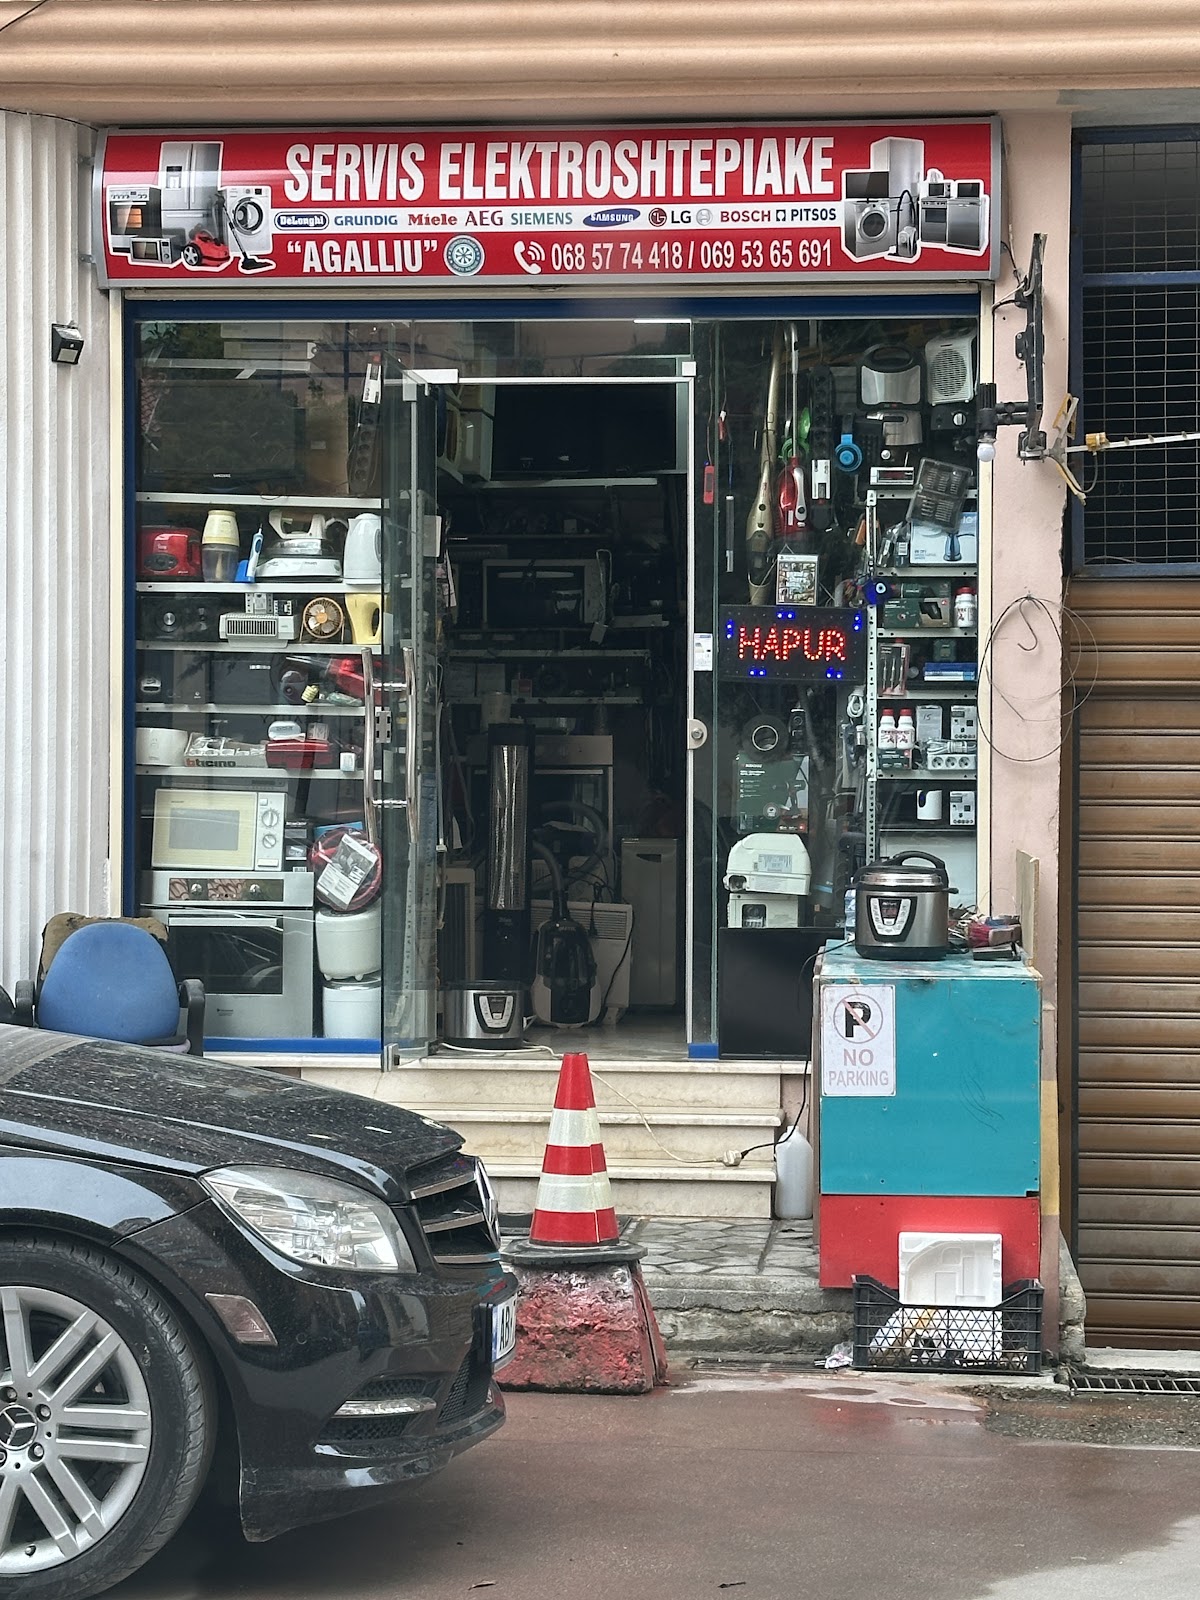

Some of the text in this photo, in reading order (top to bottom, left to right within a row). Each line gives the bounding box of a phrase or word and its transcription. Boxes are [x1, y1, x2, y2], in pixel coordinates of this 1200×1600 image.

[284, 137, 835, 202] SERVIS ELEKTROSHTEPIAKE
[334, 215, 398, 226] GRUNDIG
[408, 213, 458, 226] Miele
[465, 210, 503, 226] AEG
[511, 212, 573, 226] SIEMENS
[590, 212, 634, 223] SAMSUNG
[671, 210, 692, 224] LG
[720, 210, 771, 223] BOSCH
[790, 208, 837, 221] PITSOS
[551, 243, 586, 271] 068
[592, 242, 613, 271] 57
[619, 241, 643, 270] 74
[648, 241, 683, 269] 418
[700, 240, 735, 269] 069
[741, 240, 764, 269] 53
[769, 239, 793, 268] 65
[799, 238, 832, 267] 691
[738, 625, 846, 661] HAPUR
[843, 1048, 874, 1067] NO
[828, 1070, 889, 1088] PARKING
